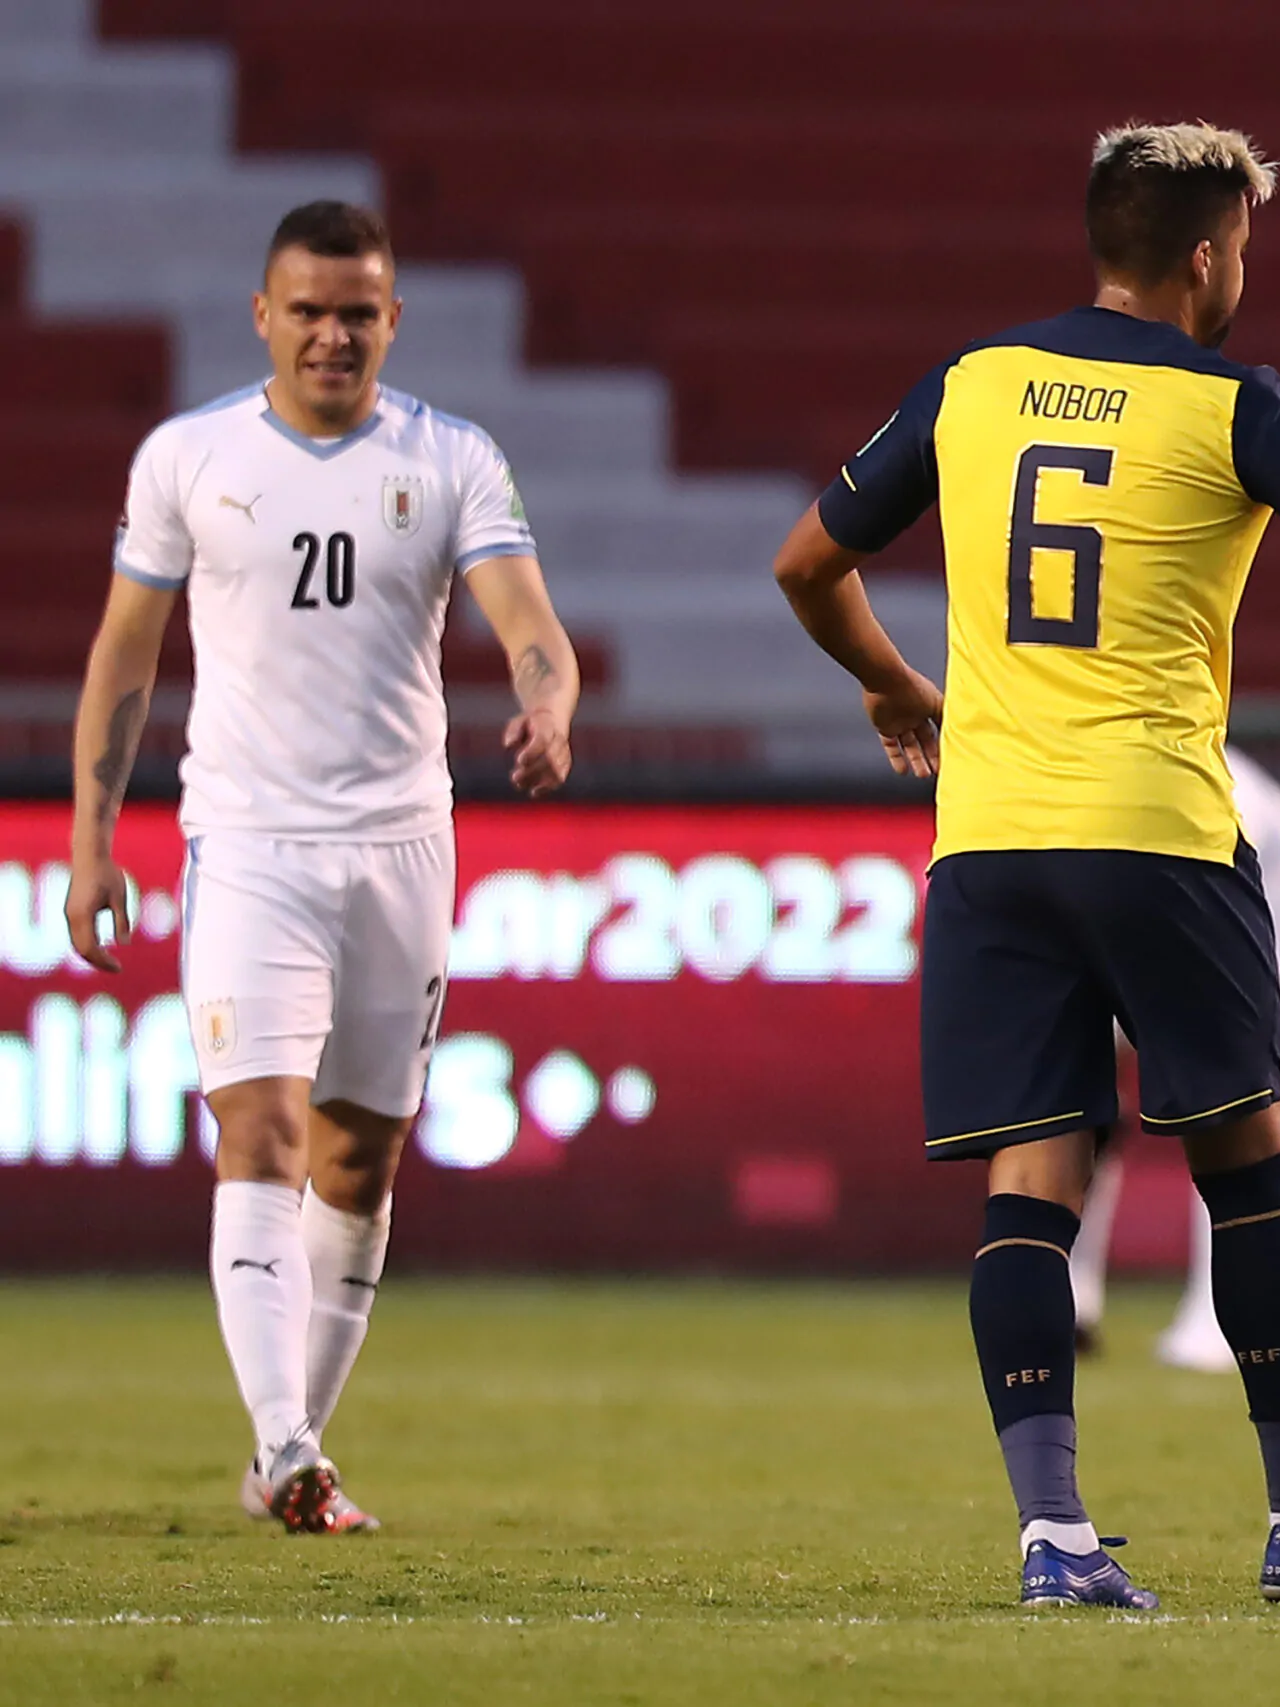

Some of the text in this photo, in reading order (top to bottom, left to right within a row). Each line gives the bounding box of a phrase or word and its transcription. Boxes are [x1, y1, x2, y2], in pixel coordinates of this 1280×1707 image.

[1019, 380, 1128, 423] NOBOA
[1006, 441, 1117, 649] 6
[290, 531, 356, 609] 20
[1238, 1348, 1280, 1364] FEF
[1005, 1369, 1051, 1387] FEF
